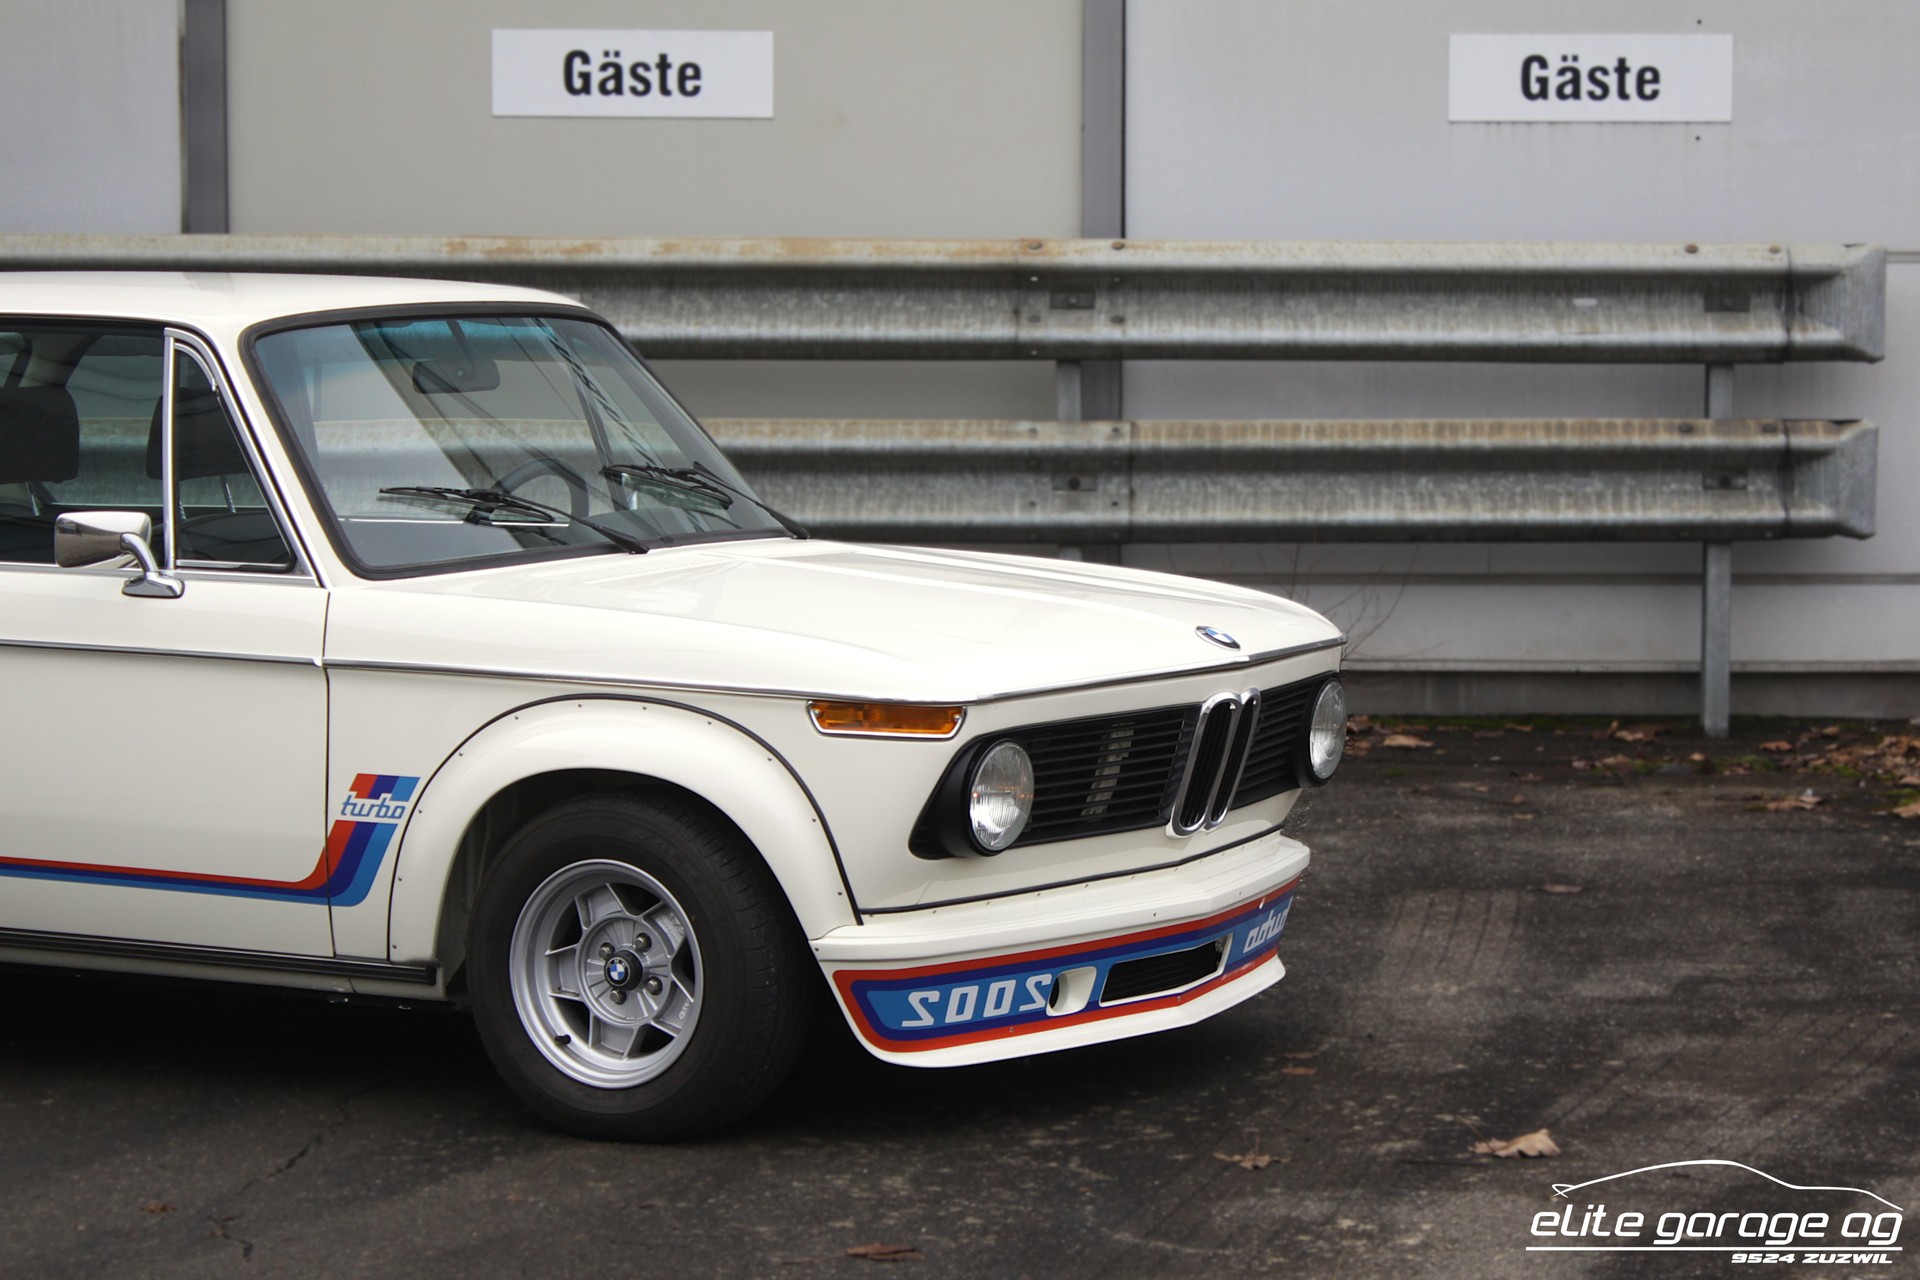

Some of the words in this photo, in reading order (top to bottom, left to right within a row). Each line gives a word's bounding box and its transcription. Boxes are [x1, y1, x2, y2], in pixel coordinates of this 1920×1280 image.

[563, 49, 702, 97] Gäste
[1520, 54, 1661, 101] Gäste
[340, 794, 406, 819] turbo
